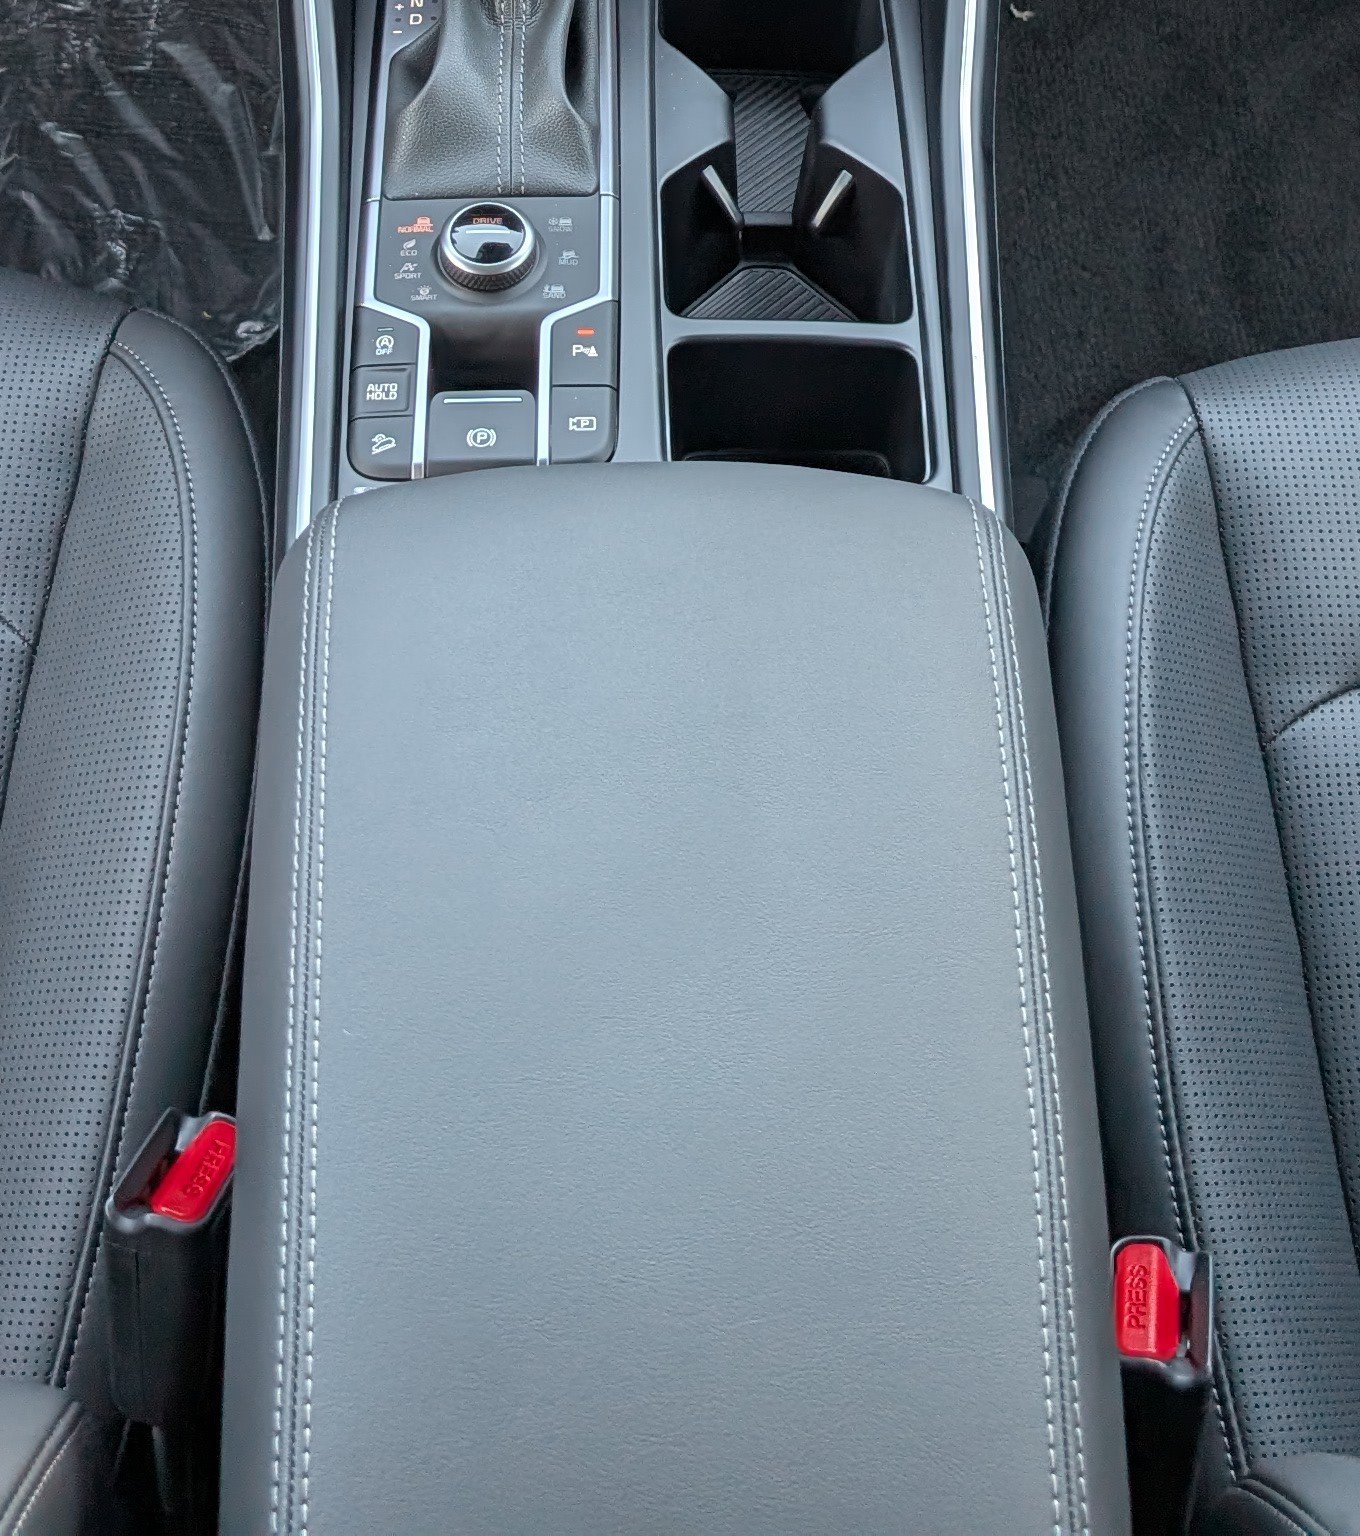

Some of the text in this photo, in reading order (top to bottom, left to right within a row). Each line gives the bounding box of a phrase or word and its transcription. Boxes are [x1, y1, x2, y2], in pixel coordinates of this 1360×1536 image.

[409, 14, 423, 25] D
[397, 226, 434, 234] NORMAL
[366, 383, 398, 392] AUTO
[366, 391, 398, 400] HOLD
[1125, 1264, 1149, 1330] PRESS
